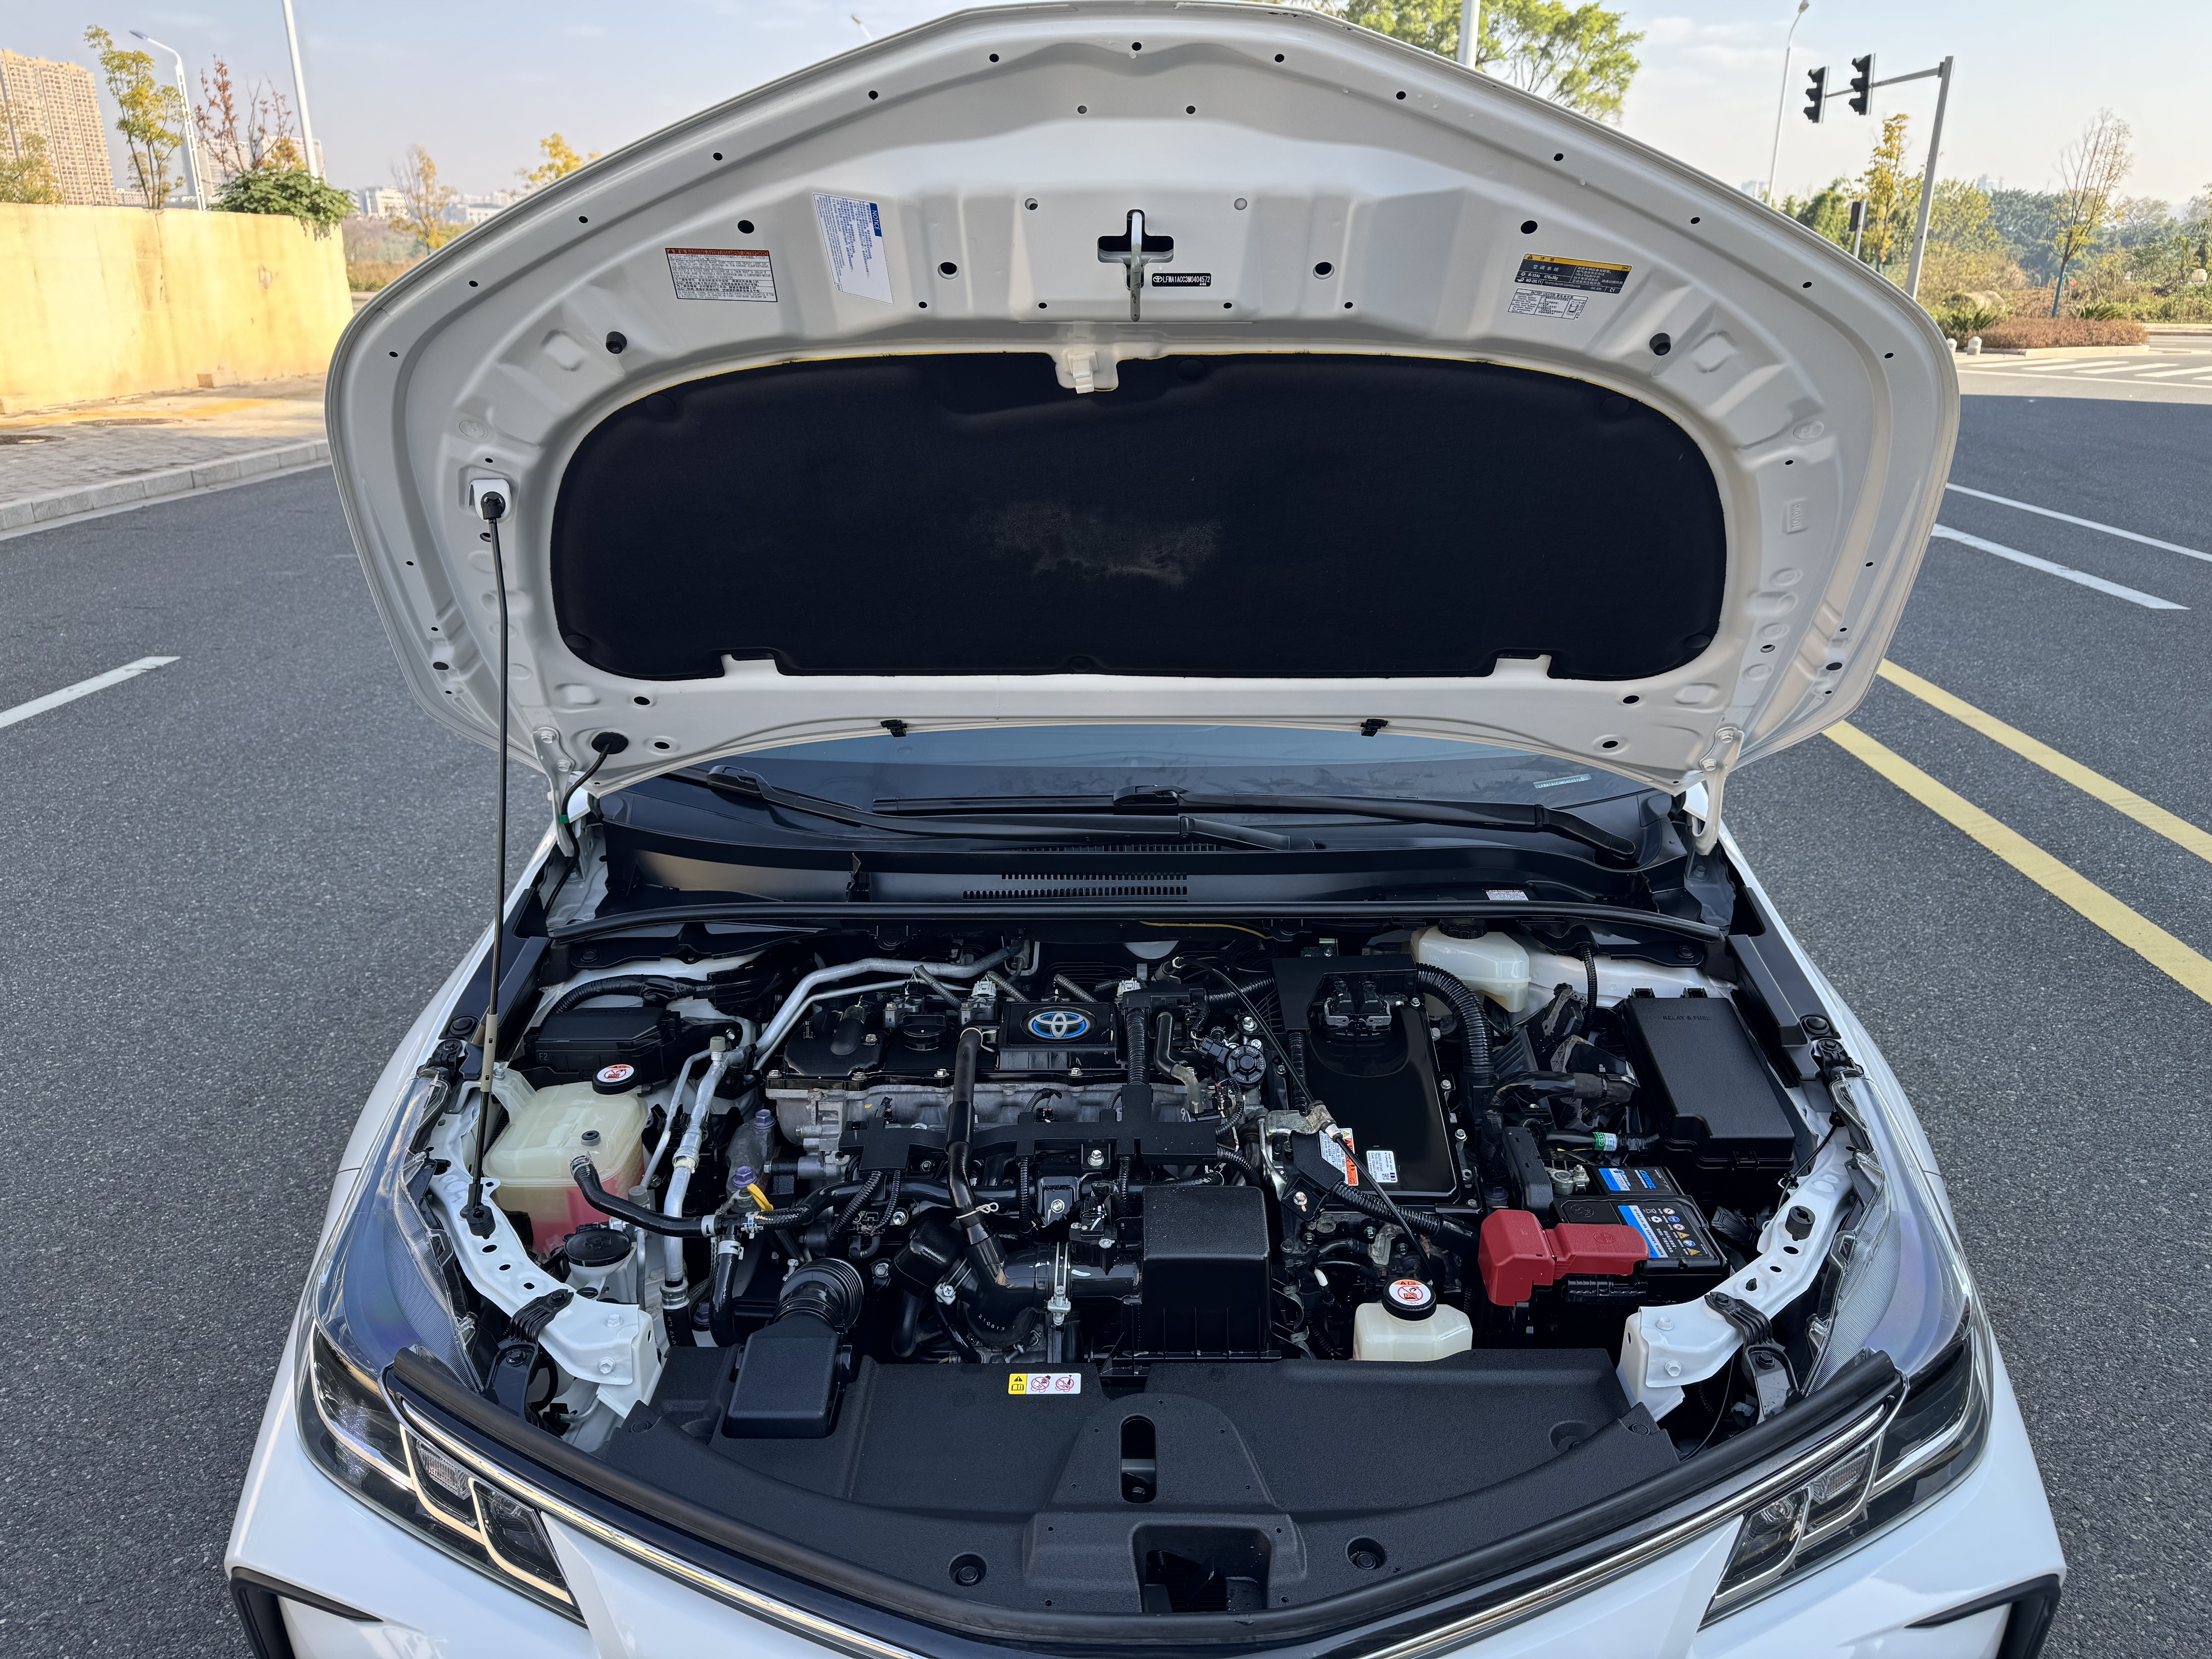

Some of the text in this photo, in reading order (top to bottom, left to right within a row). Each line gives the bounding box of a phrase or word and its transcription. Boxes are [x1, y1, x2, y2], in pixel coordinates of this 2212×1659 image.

[872, 210, 880, 230] NOTICE
[1791, 503, 1801, 530] TOYOTA
[1638, 1170, 1656, 1189] CAMEL
[668, 1317, 673, 1326] LP
